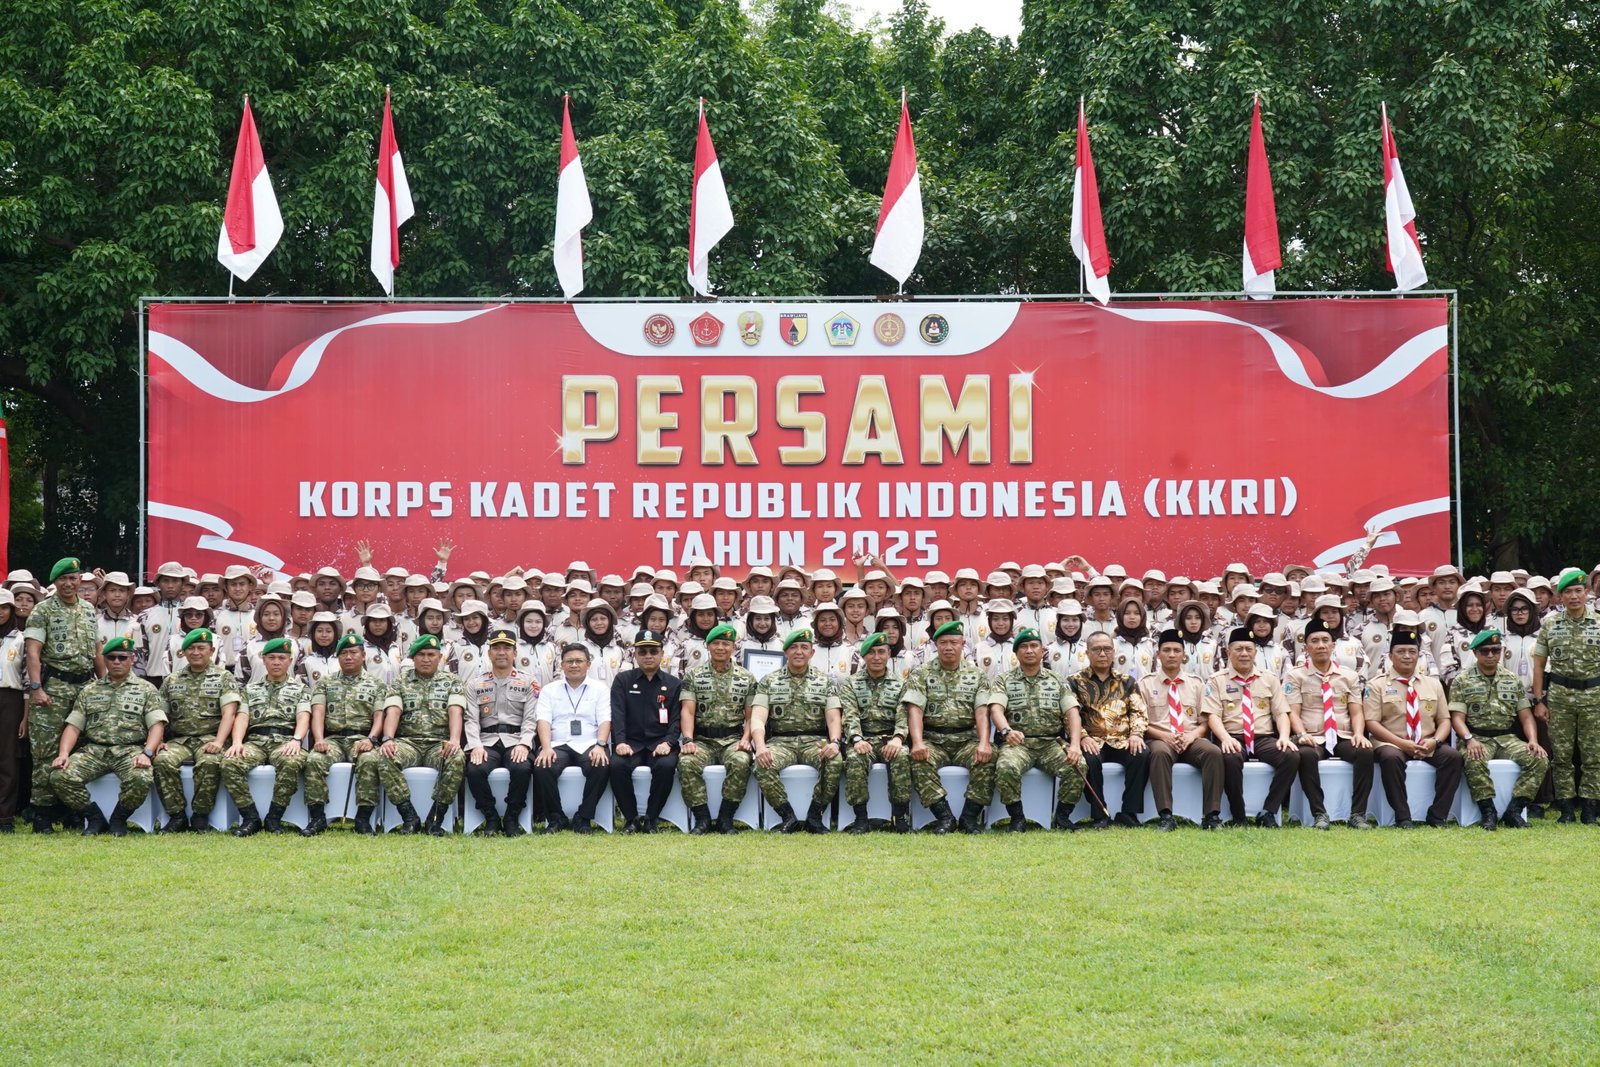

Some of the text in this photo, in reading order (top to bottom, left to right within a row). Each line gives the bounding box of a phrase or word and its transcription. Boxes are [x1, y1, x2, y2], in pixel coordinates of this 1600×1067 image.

[561, 374, 1033, 466] PERSAMI
[298, 476, 1298, 519] KORPS KADET REPUBLIK INDONESIA (KKRI)
[655, 530, 939, 567] TAHUN 2025
